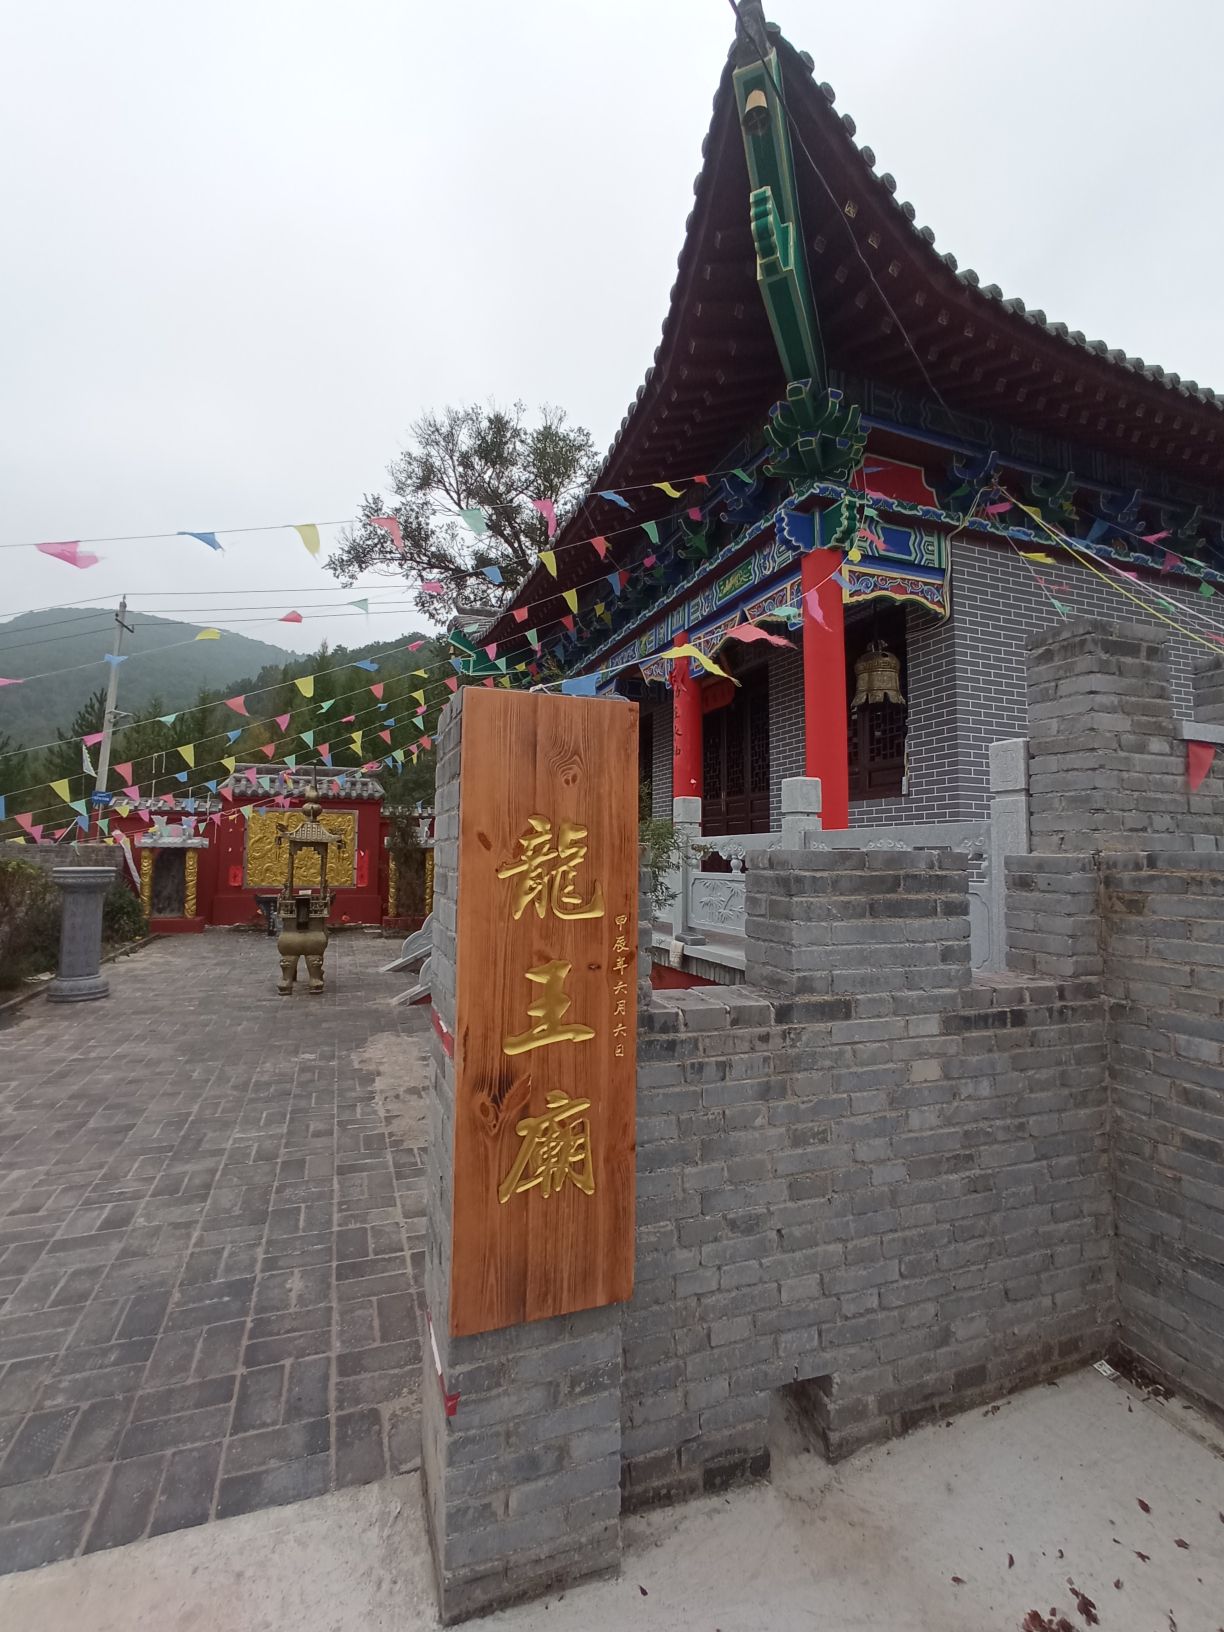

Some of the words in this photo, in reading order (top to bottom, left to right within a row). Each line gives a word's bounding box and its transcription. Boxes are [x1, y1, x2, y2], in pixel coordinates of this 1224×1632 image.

[498, 814, 605, 1204] 龍王廟
[612, 914, 629, 1057] 甲辰年六月六日
